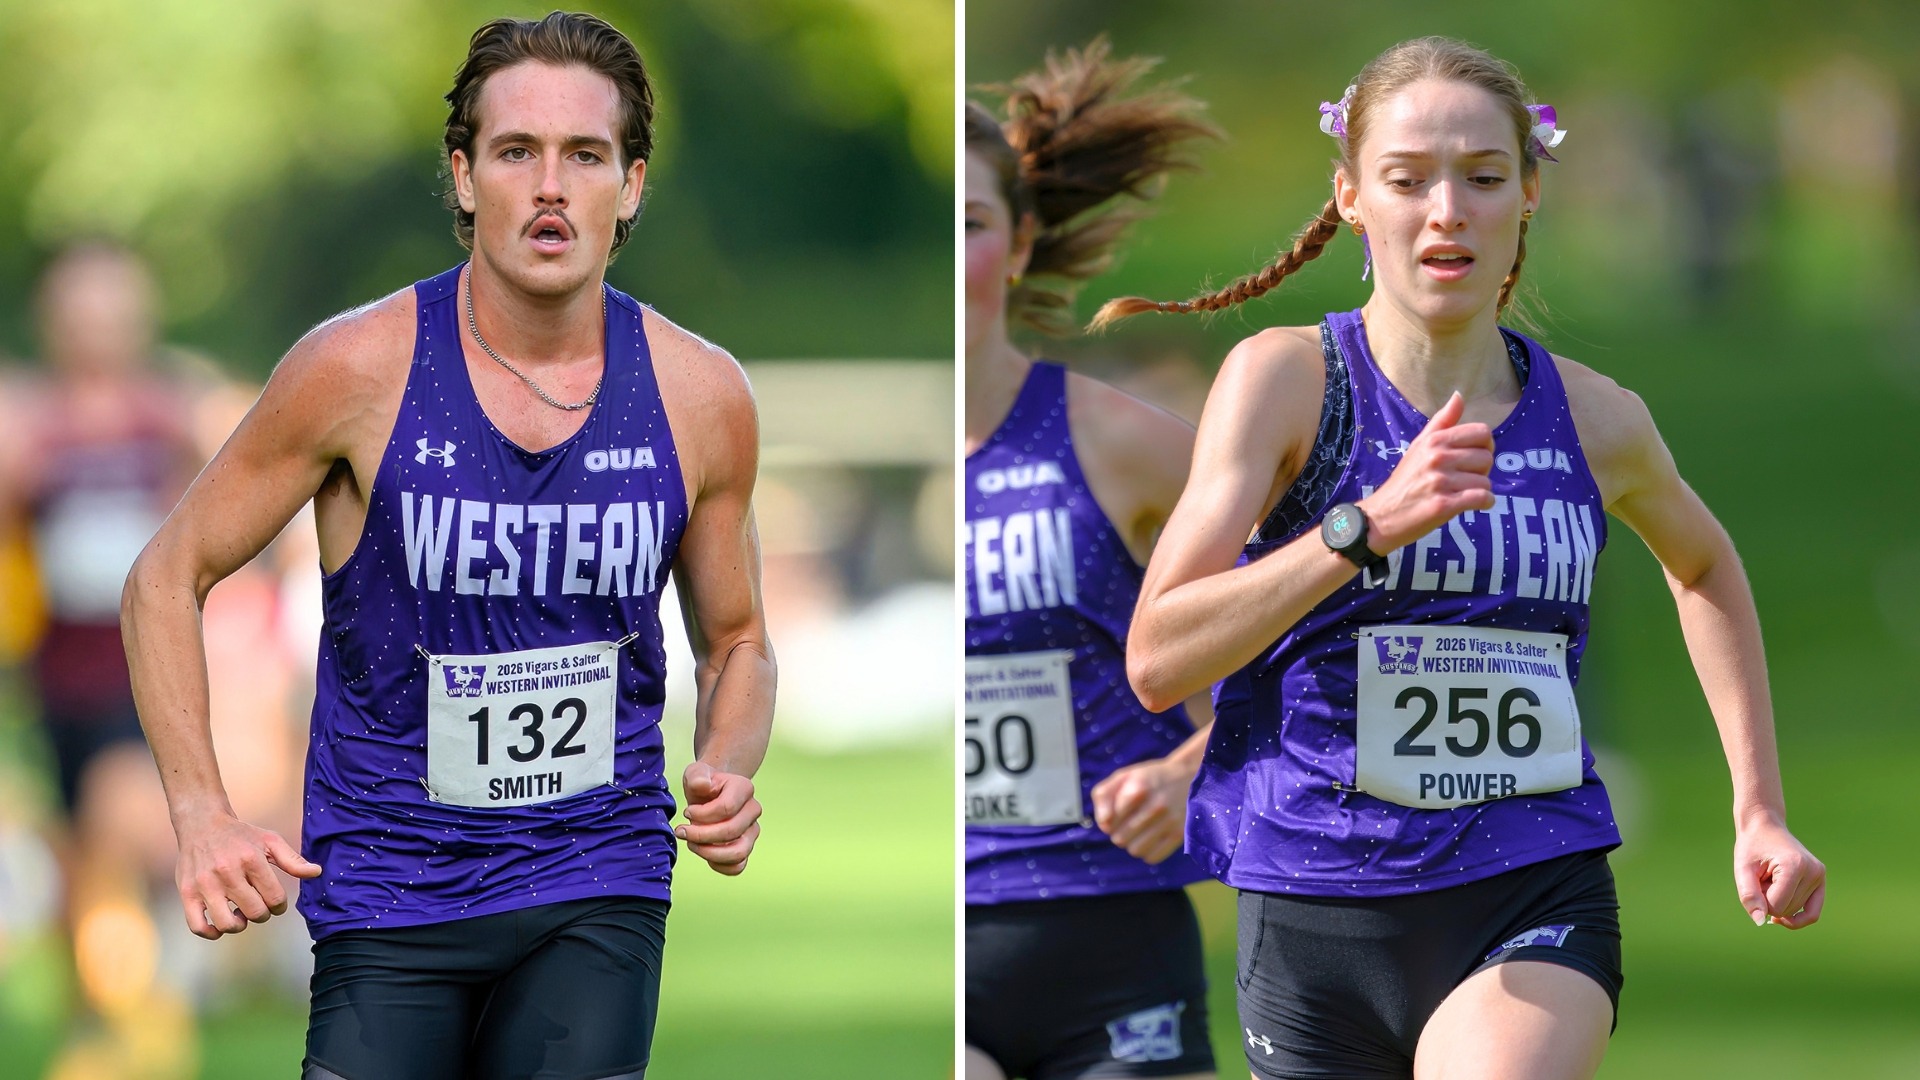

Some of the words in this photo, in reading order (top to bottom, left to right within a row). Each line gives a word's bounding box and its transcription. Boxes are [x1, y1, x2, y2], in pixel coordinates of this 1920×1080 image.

[584, 447, 657, 472] OUA
[1495, 449, 1573, 474] OUA
[976, 461, 1066, 494] OUA
[401, 491, 665, 598] WESTERN
[1436, 637, 1466, 652] 2026
[1469, 638, 1503, 655] Vigars
[1505, 641, 1514, 654] &
[1516, 642, 1548, 659] Salter
[497, 662, 523, 676] 2026
[525, 660, 558, 675] Vigars
[560, 657, 570, 669] &
[572, 653, 601, 668] Salter
[1423, 657, 1485, 673] WESTERN
[1487, 658, 1562, 680] INVITATIONAL
[486, 678, 540, 695] WESTERN
[541, 666, 610, 690] INVITATIONAL
[468, 697, 587, 766] 132
[1393, 686, 1541, 758] 256
[488, 771, 563, 801] SMITH
[1419, 773, 1517, 801] POWER
